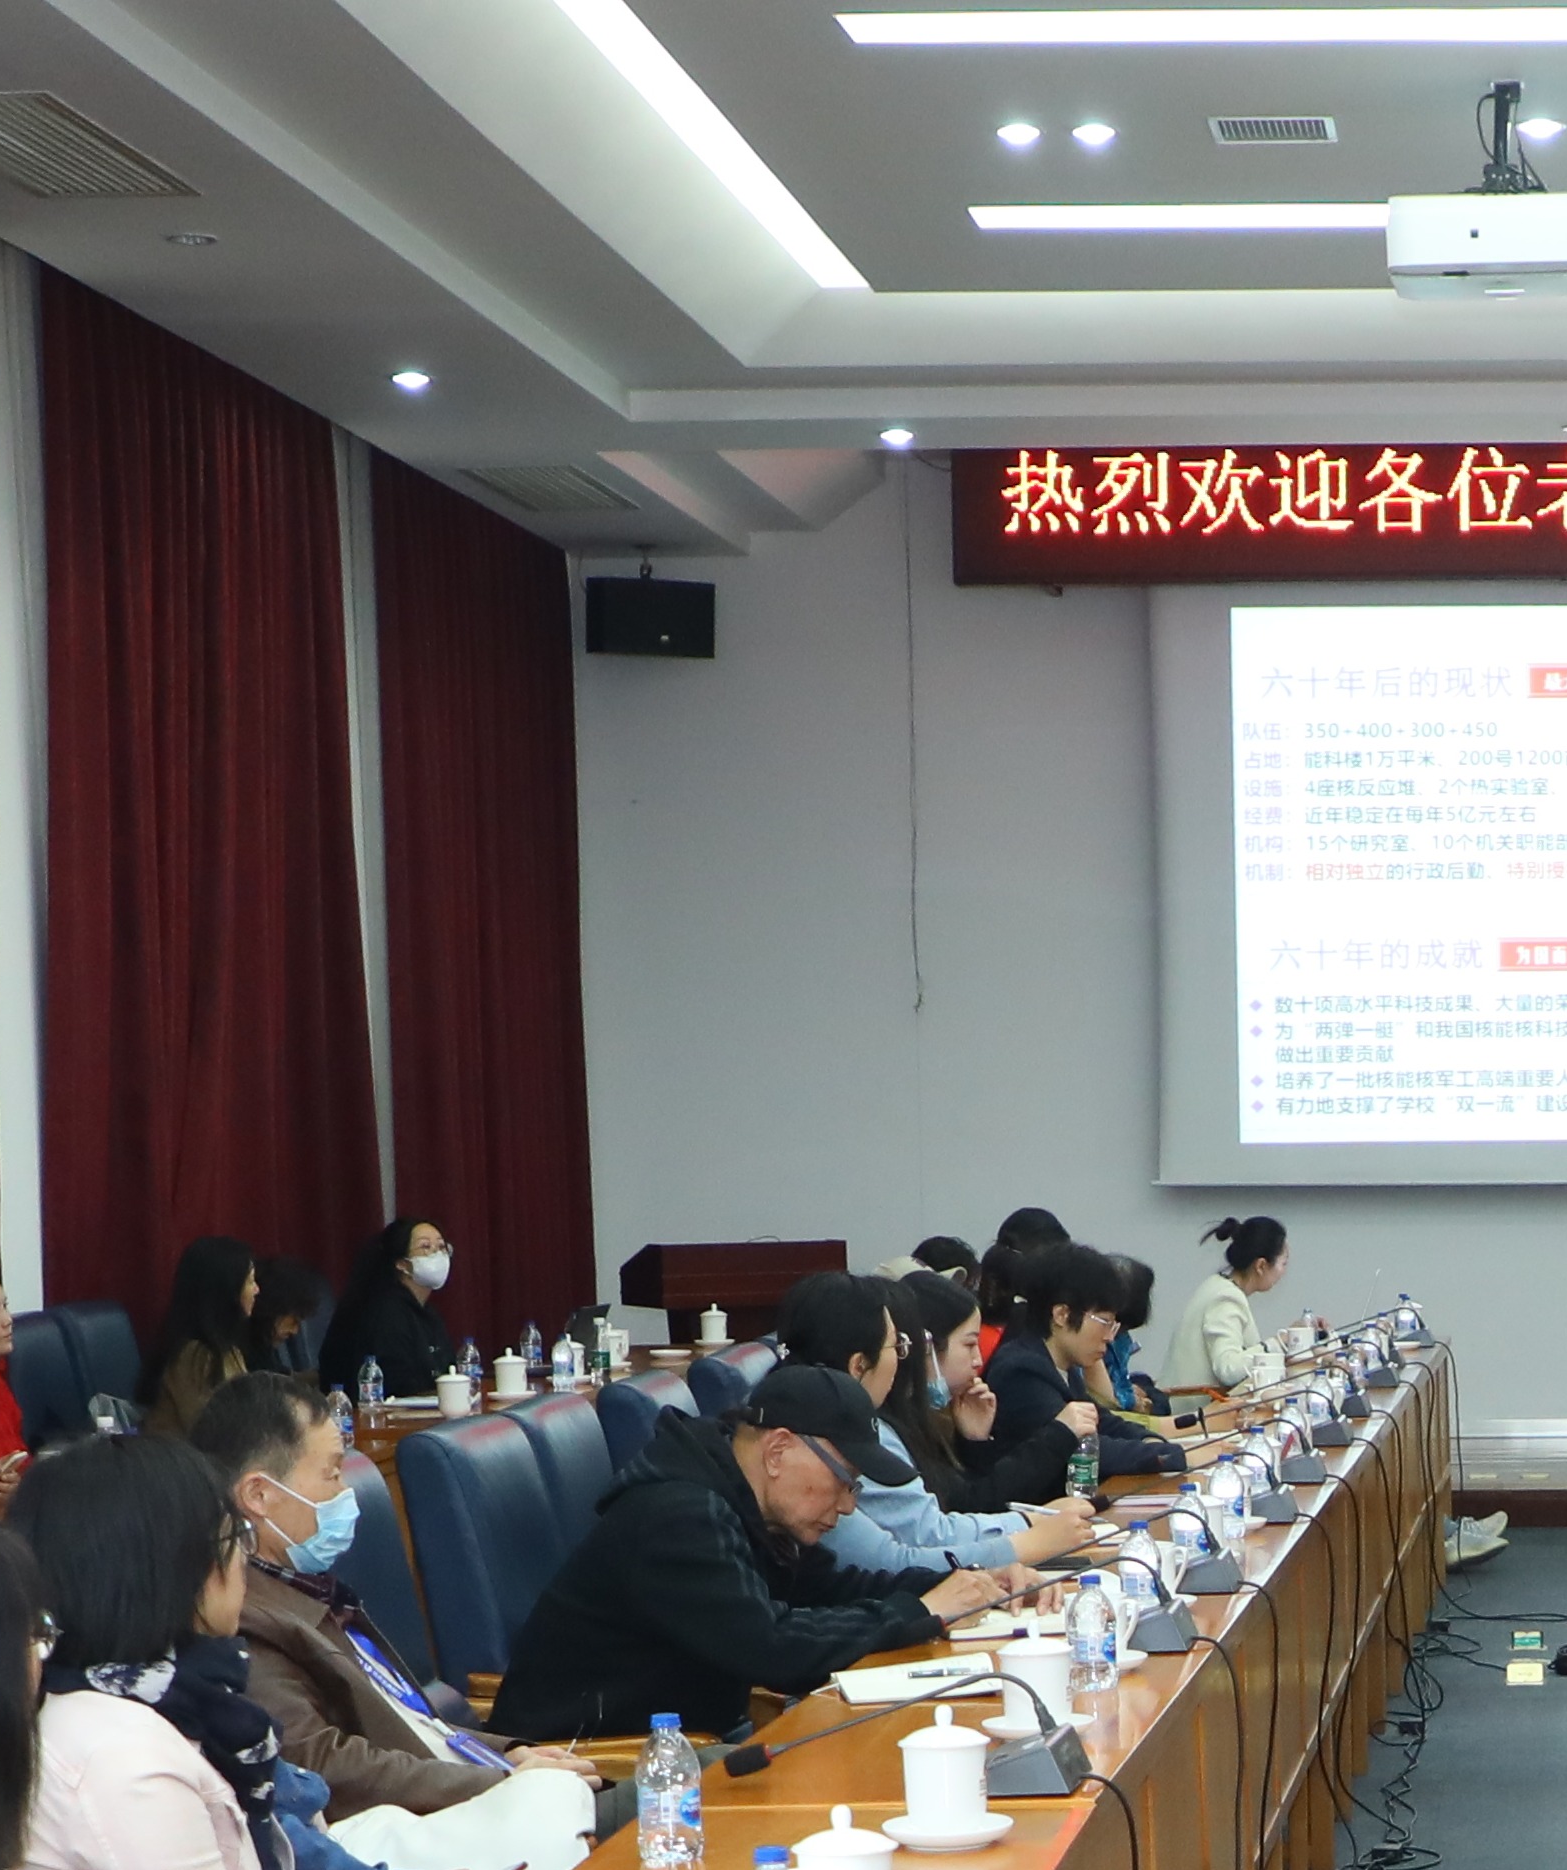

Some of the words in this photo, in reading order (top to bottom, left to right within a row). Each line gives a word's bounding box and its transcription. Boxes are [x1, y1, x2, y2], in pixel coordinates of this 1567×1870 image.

[1259, 665, 1514, 700] 六十年后的现状
[1268, 938, 1483, 970] 六十年的成就
[1274, 1044, 1394, 1064] 做出重要贡献
